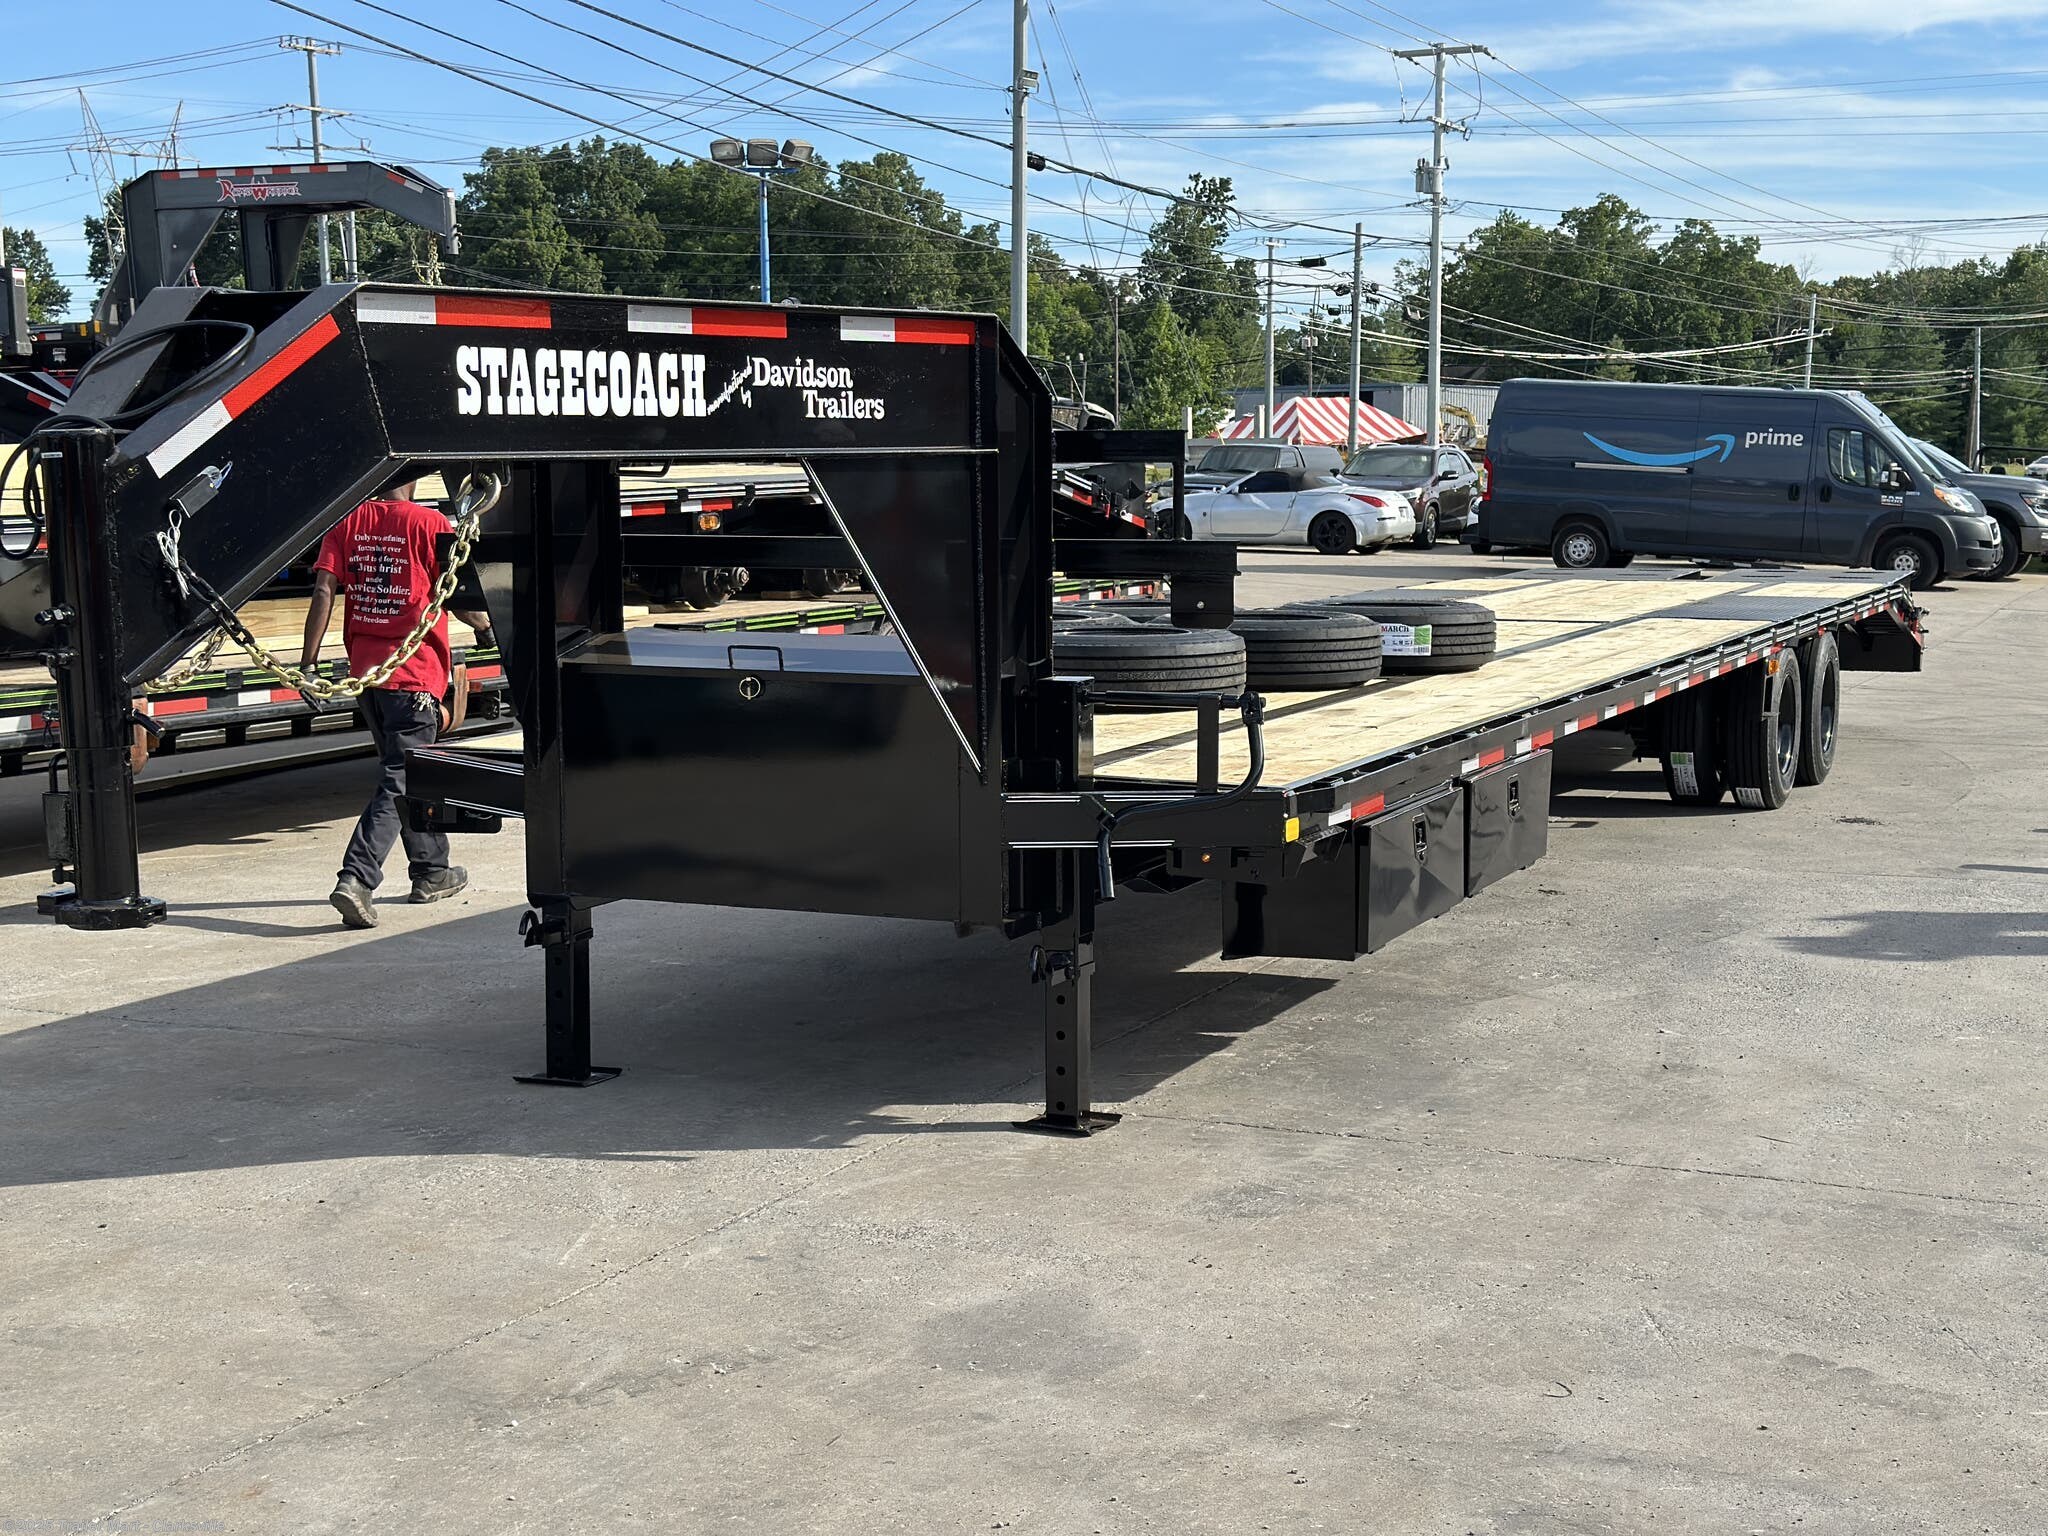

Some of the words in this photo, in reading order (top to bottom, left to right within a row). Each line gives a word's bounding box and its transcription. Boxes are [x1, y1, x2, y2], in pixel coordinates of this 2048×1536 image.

[456, 344, 707, 417] STAGECOACH
[751, 355, 854, 388] Davidson
[802, 389, 885, 420] Trailers
[1745, 428, 1804, 448] prime
[354, 533, 371, 543] Only
[379, 563, 402, 574] hrist
[376, 584, 411, 596] Soldier.
